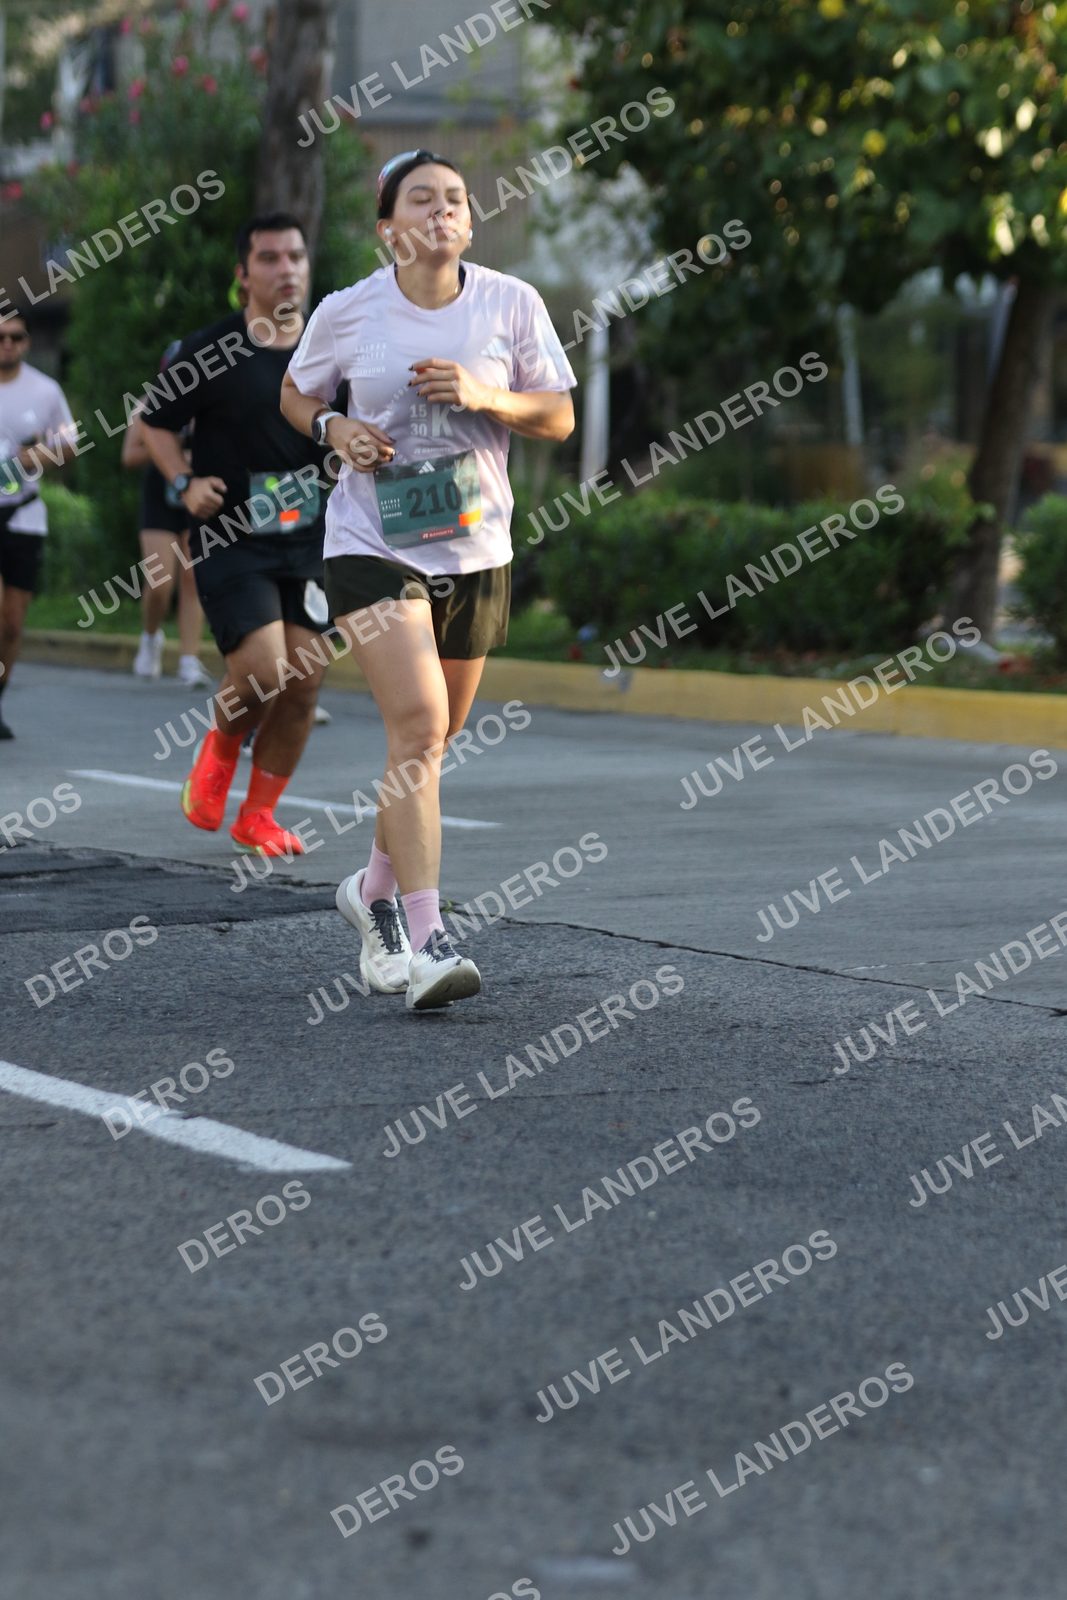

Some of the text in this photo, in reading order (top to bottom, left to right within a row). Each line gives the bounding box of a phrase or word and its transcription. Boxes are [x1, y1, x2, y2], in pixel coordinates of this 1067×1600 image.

[410, 404, 427, 418] 15
[431, 403, 453, 437] K
[410, 423, 427, 437] 30
